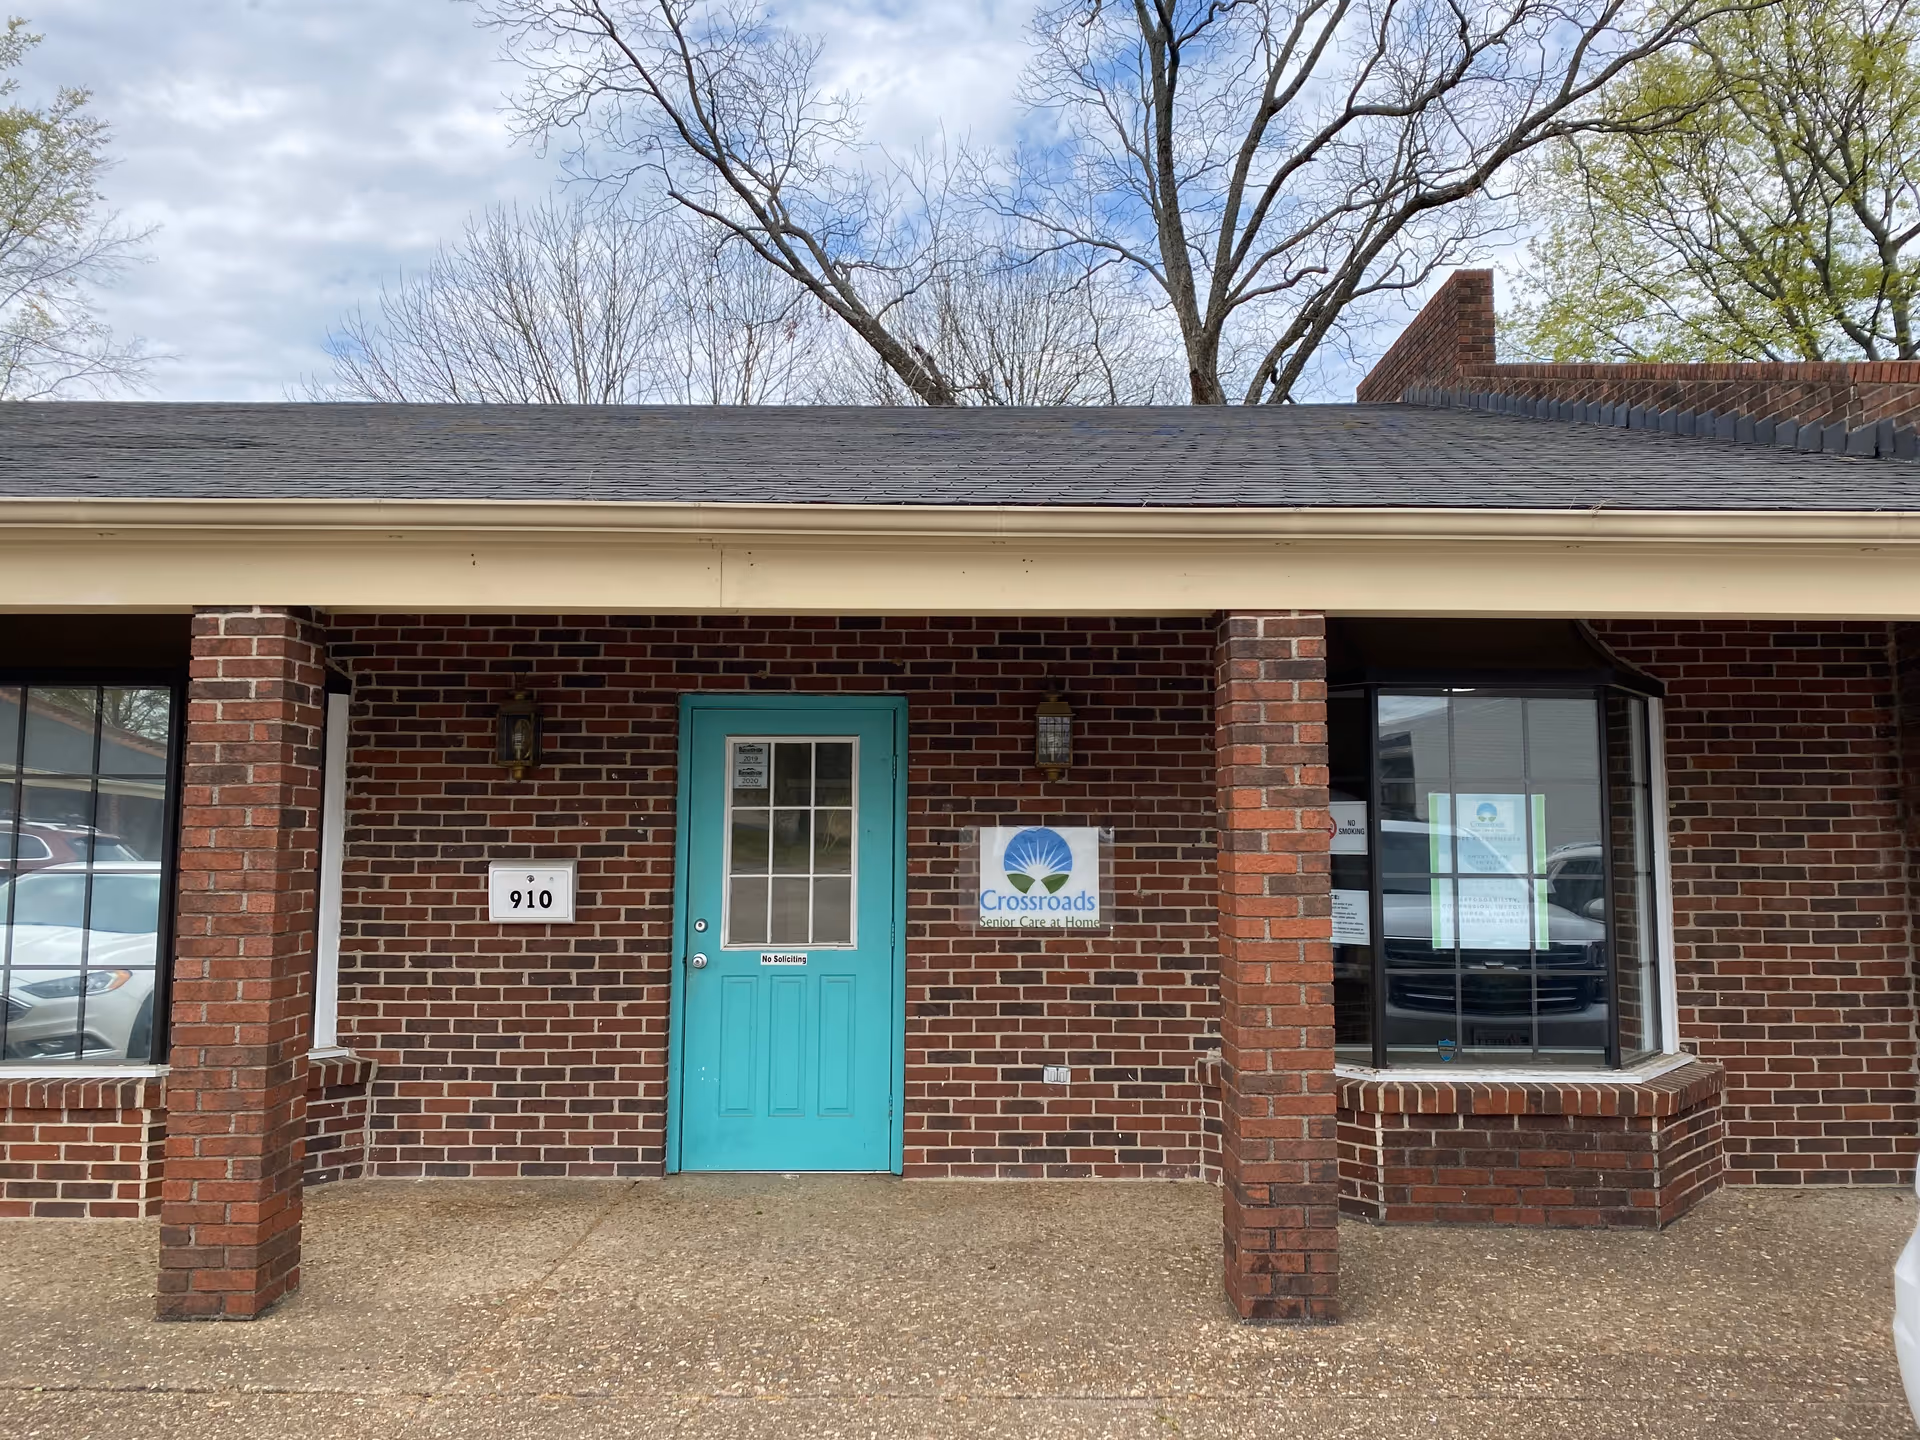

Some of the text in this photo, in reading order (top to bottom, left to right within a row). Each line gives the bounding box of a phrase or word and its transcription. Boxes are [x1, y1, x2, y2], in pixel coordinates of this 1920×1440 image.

[510, 890, 552, 908] 910
[980, 889, 1095, 911] Crossroads
[980, 916, 1100, 927] Senior Care at Home
[762, 955, 807, 964] No Soliciting
